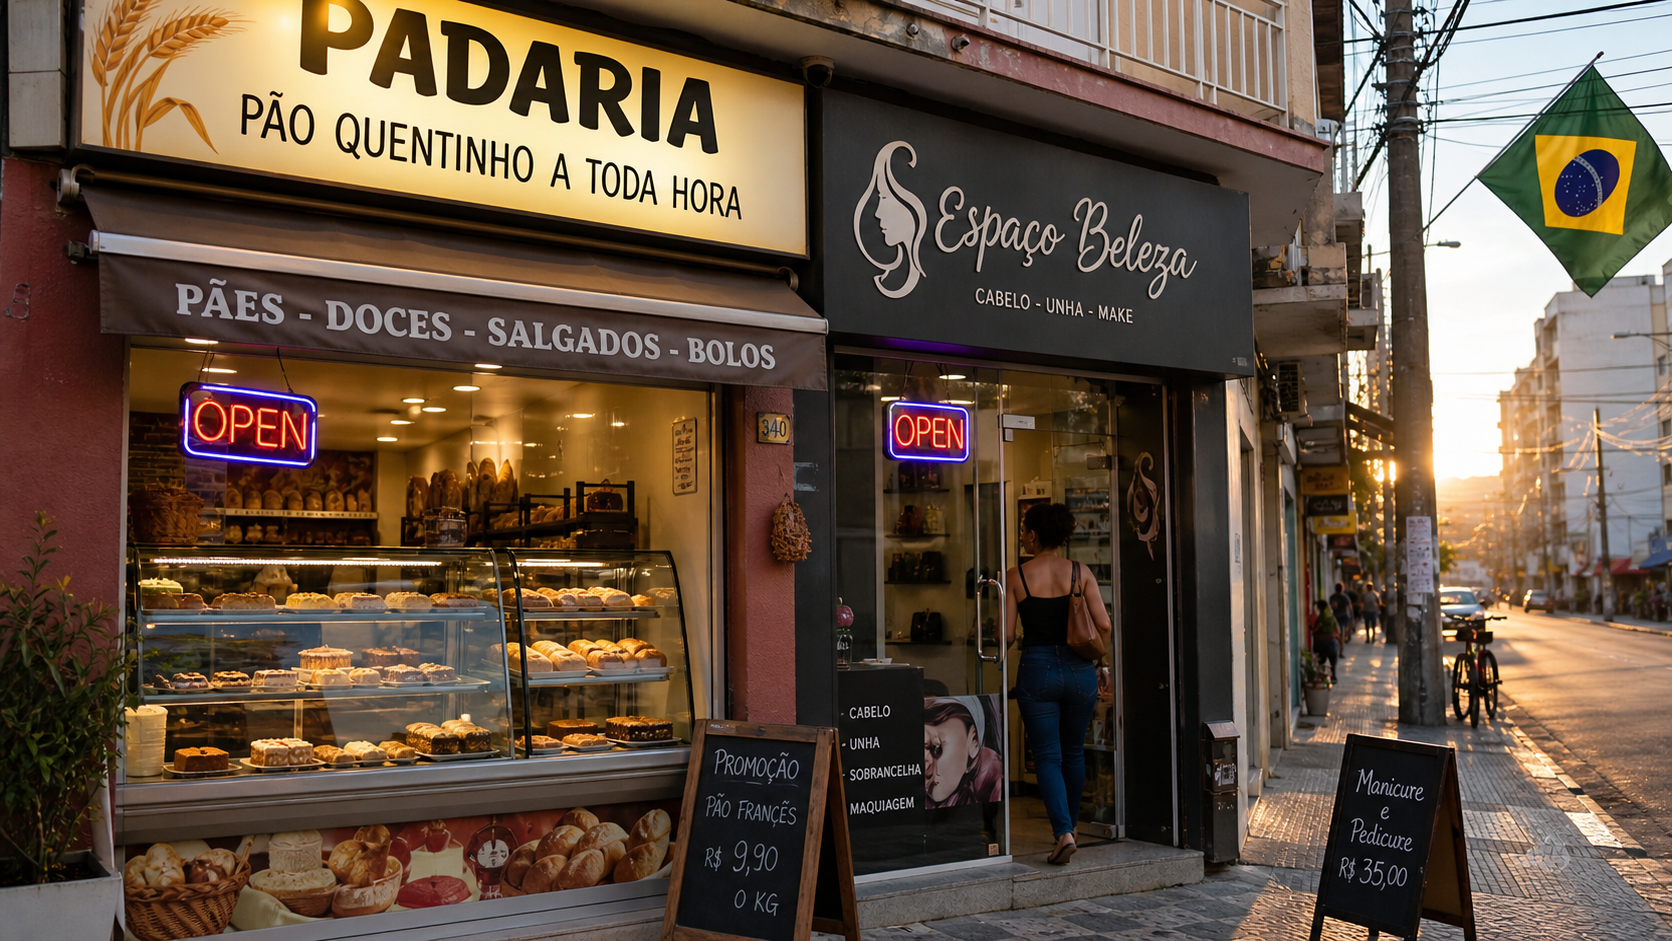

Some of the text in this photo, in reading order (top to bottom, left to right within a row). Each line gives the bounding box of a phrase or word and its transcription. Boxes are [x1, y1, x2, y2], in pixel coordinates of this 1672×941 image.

[299, 0, 719, 154] PADARIA
[241, 90, 743, 221] PÃO QUENTINHO A TODA HORA
[934, 185, 1198, 300] Espaço Beleza
[975, 287, 1031, 311] CABELO
[1046, 297, 1084, 318] UNHA
[1098, 304, 1134, 325] MAKE
[175, 277, 286, 326] PÃES
[325, 299, 453, 343] DOCES
[487, 316, 661, 361] SALGADOS
[686, 336, 777, 371] BOLOS
[193, 399, 308, 451] OPEN
[761, 418, 787, 439] 340
[894, 413, 965, 451] OPEN
[849, 704, 891, 720] CABELO
[849, 736, 881, 751] UNHA
[849, 762, 922, 782] SOBRANCELHA
[1355, 767, 1425, 802] Manicure
[705, 792, 732, 818] PÃO
[850, 795, 915, 816] MAQUIAGEM
[1380, 806, 1391, 820] e
[1350, 817, 1414, 852] Pedicure
[704, 839, 779, 877] R$ 9,90
[1338, 856, 1408, 891] R$ 35,00
[753, 890, 779, 917] KG
